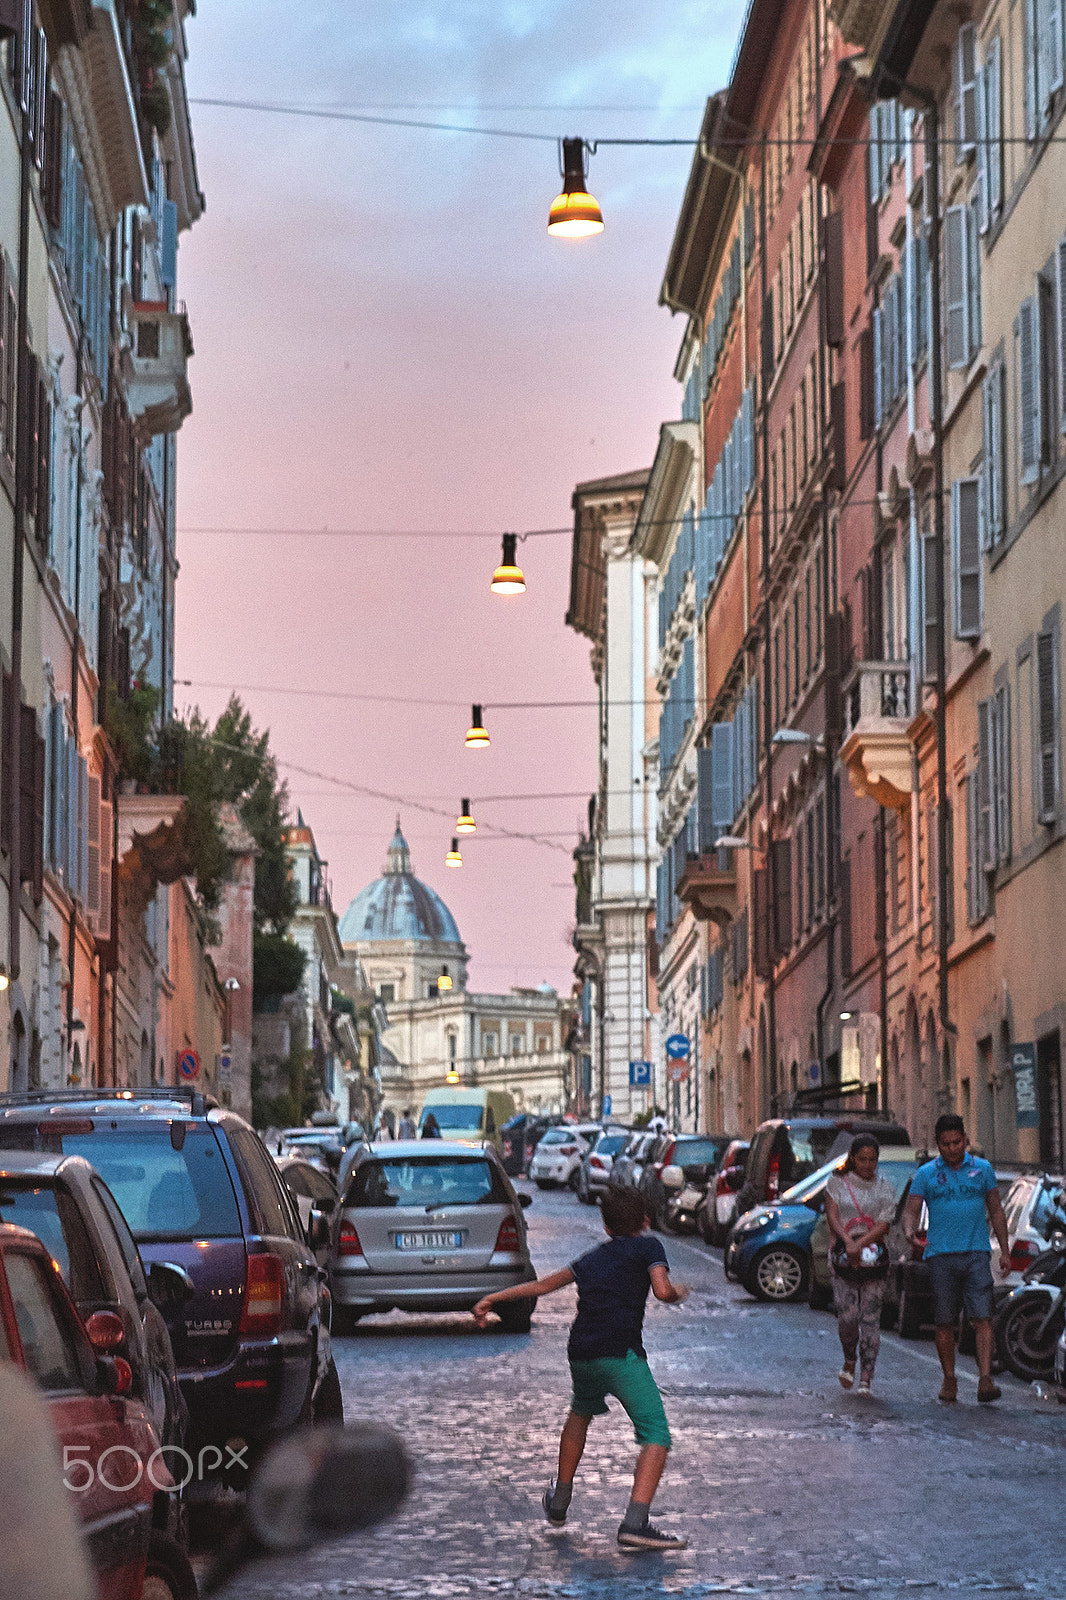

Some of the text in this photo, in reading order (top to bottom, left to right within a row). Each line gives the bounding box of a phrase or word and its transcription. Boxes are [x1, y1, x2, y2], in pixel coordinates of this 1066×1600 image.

[1013, 1053, 1033, 1065] P
[634, 1064, 648, 1082] P
[185, 1320, 232, 1330] TURBO
